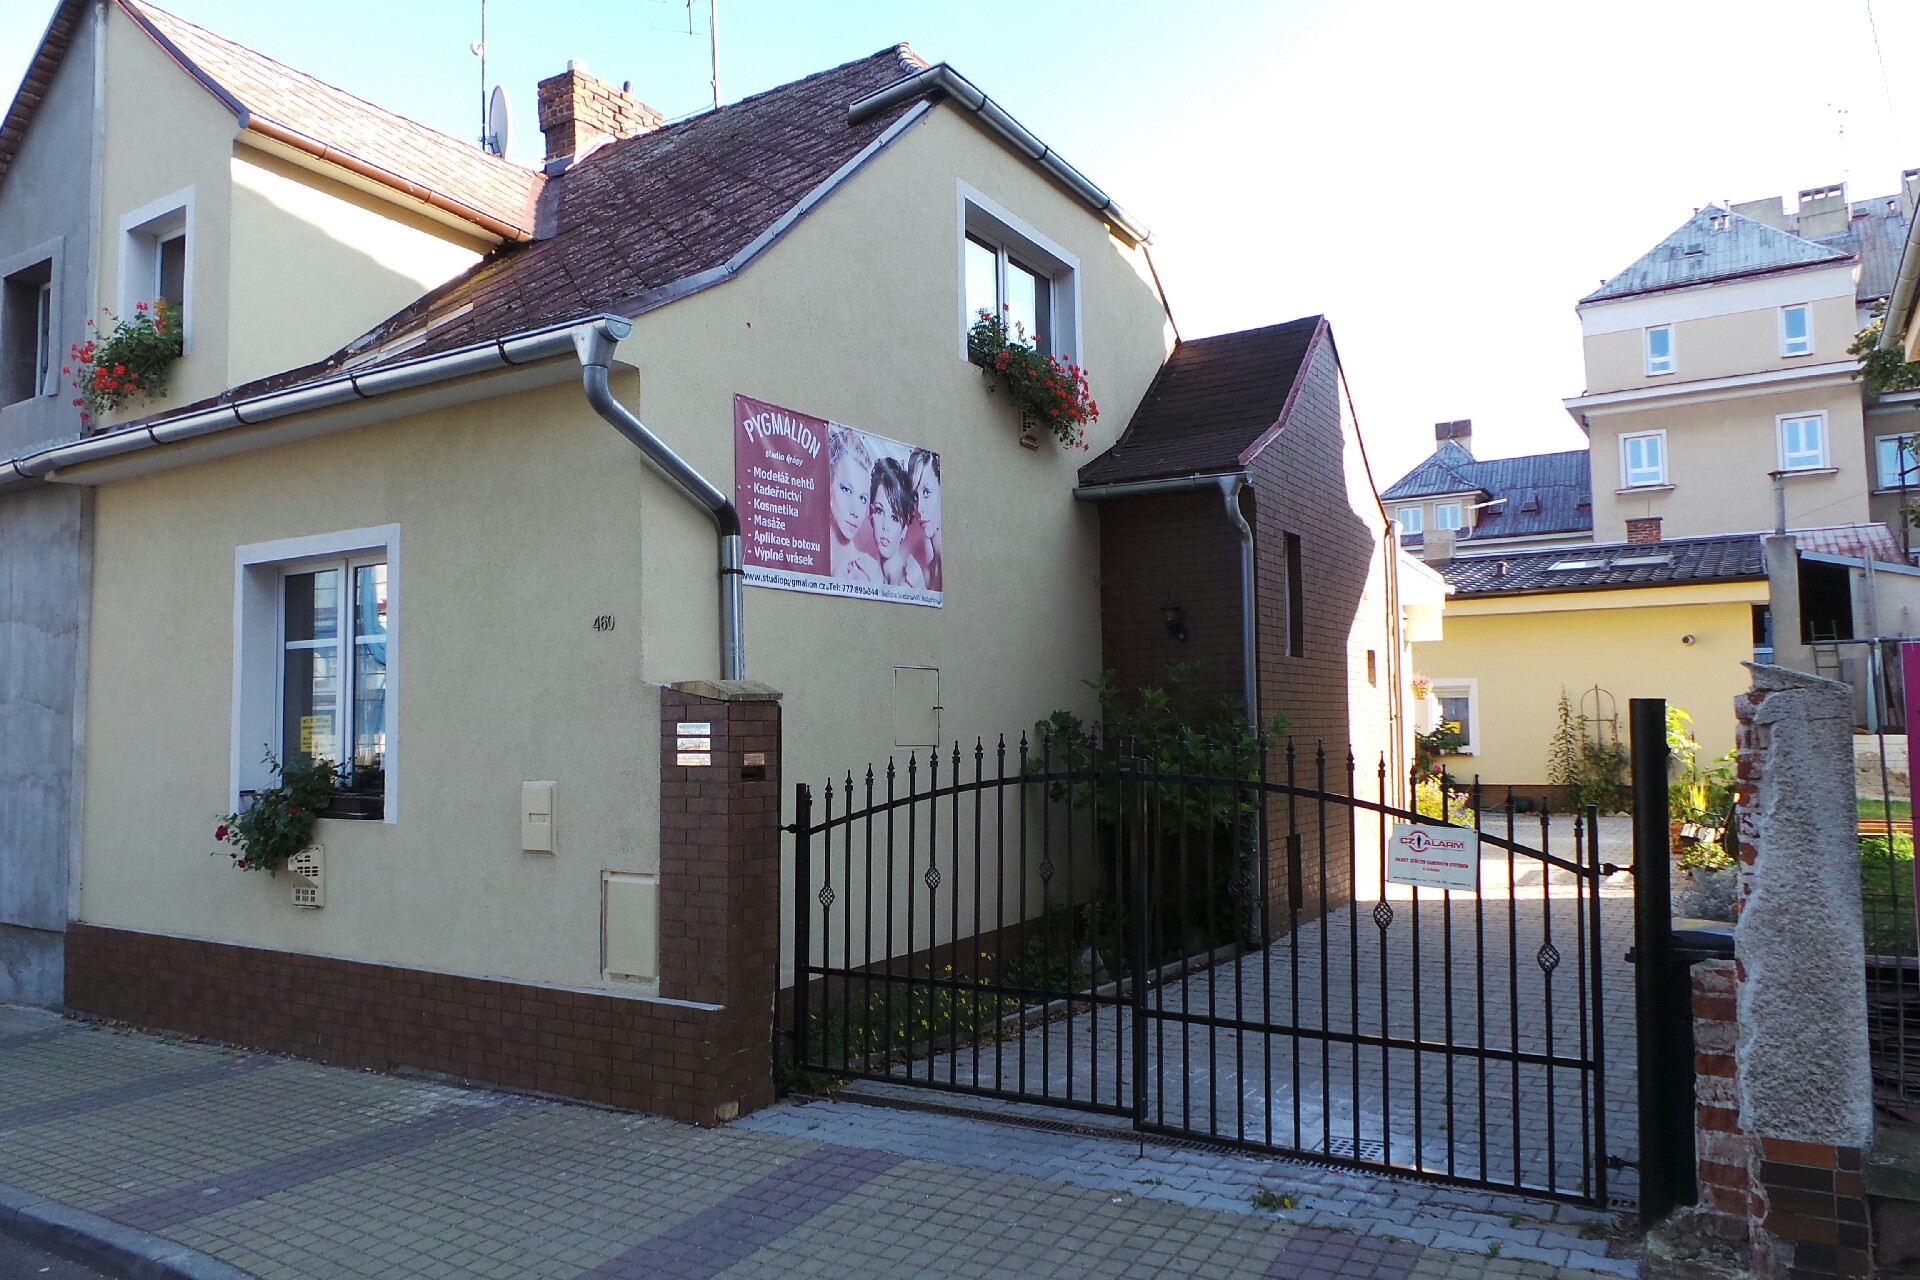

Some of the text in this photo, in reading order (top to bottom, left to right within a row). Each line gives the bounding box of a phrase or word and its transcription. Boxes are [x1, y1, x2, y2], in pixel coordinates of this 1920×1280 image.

[743, 412, 821, 459] PYGMALION
[765, 449, 785, 461] studio
[753, 466, 815, 490] Modeláž nehtů
[753, 482, 802, 503] Kadeřnictví
[753, 498, 799, 517] Kosmetika
[754, 514, 786, 531] Masáže
[754, 530, 821, 551] Aplikace botoxu
[754, 546, 814, 565] Výplně vrásek
[828, 582, 841, 592] Tel:
[842, 584, 854, 593] 777
[592, 614, 616, 632] 460
[1400, 837, 1465, 849] CZ ALARM
